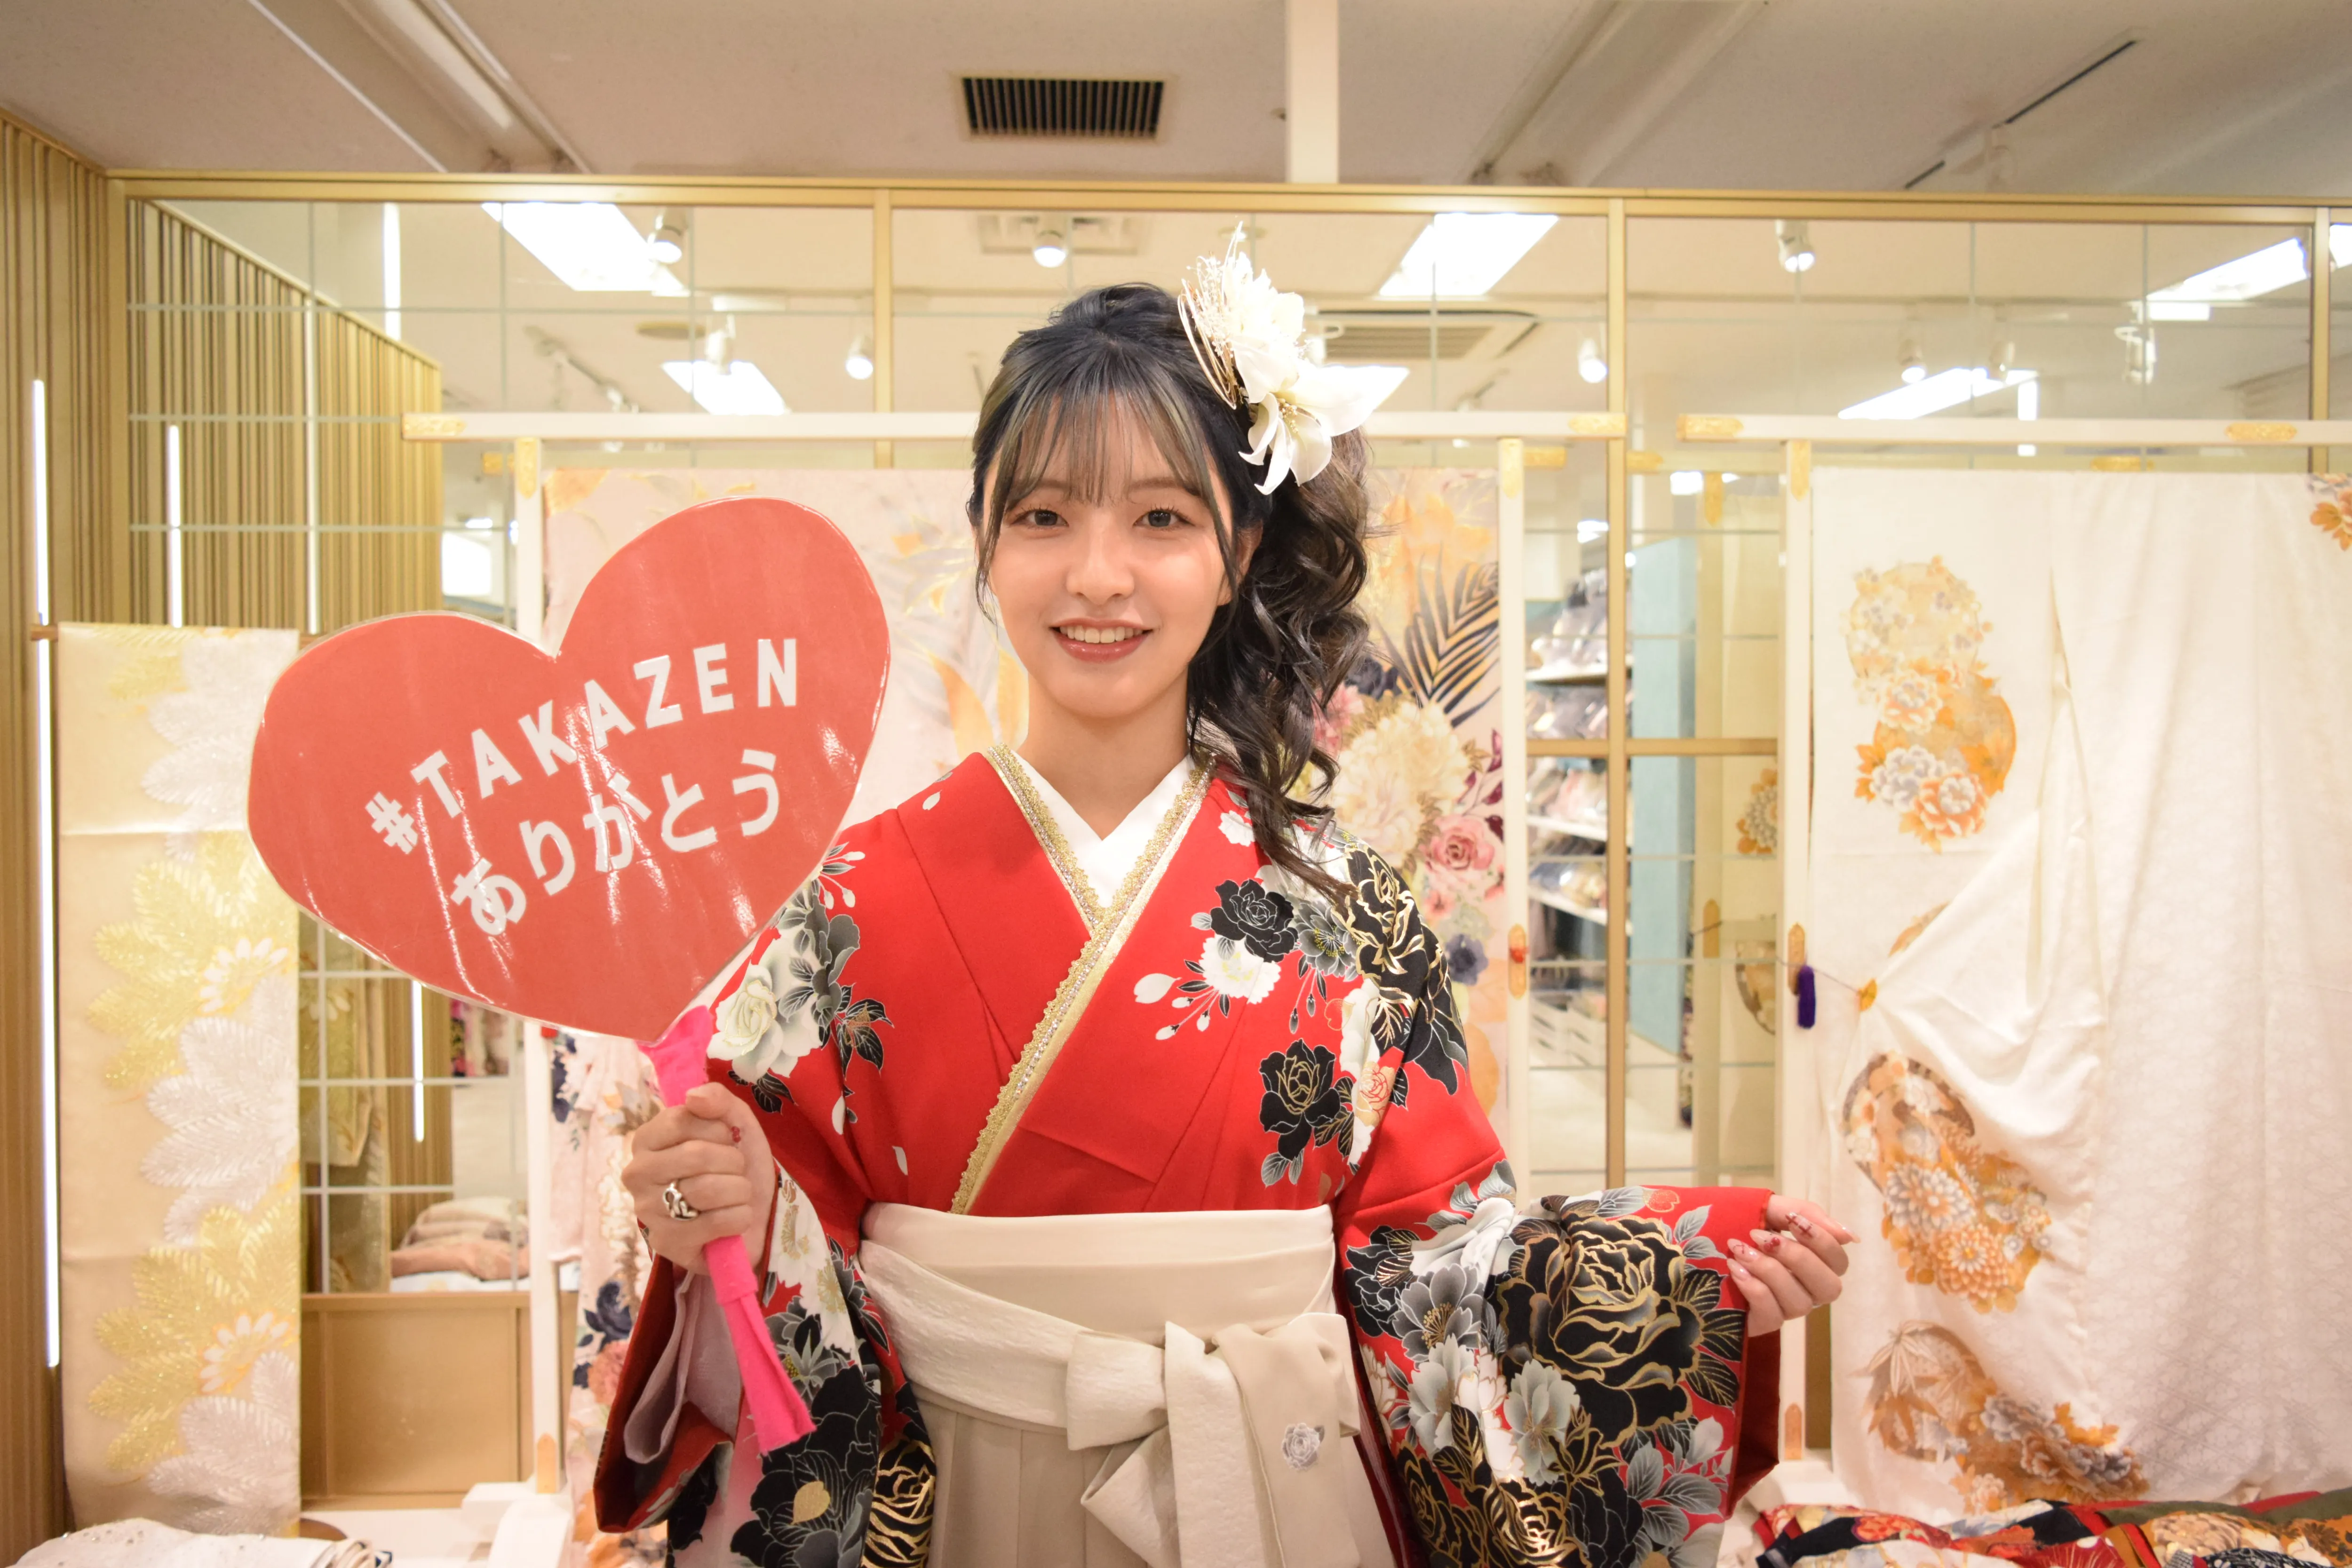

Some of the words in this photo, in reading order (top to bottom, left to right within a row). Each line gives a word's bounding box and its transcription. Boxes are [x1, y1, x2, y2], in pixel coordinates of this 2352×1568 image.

[365, 638, 797, 854] #TAKAZEN
[451, 749, 779, 935] ありがとう
